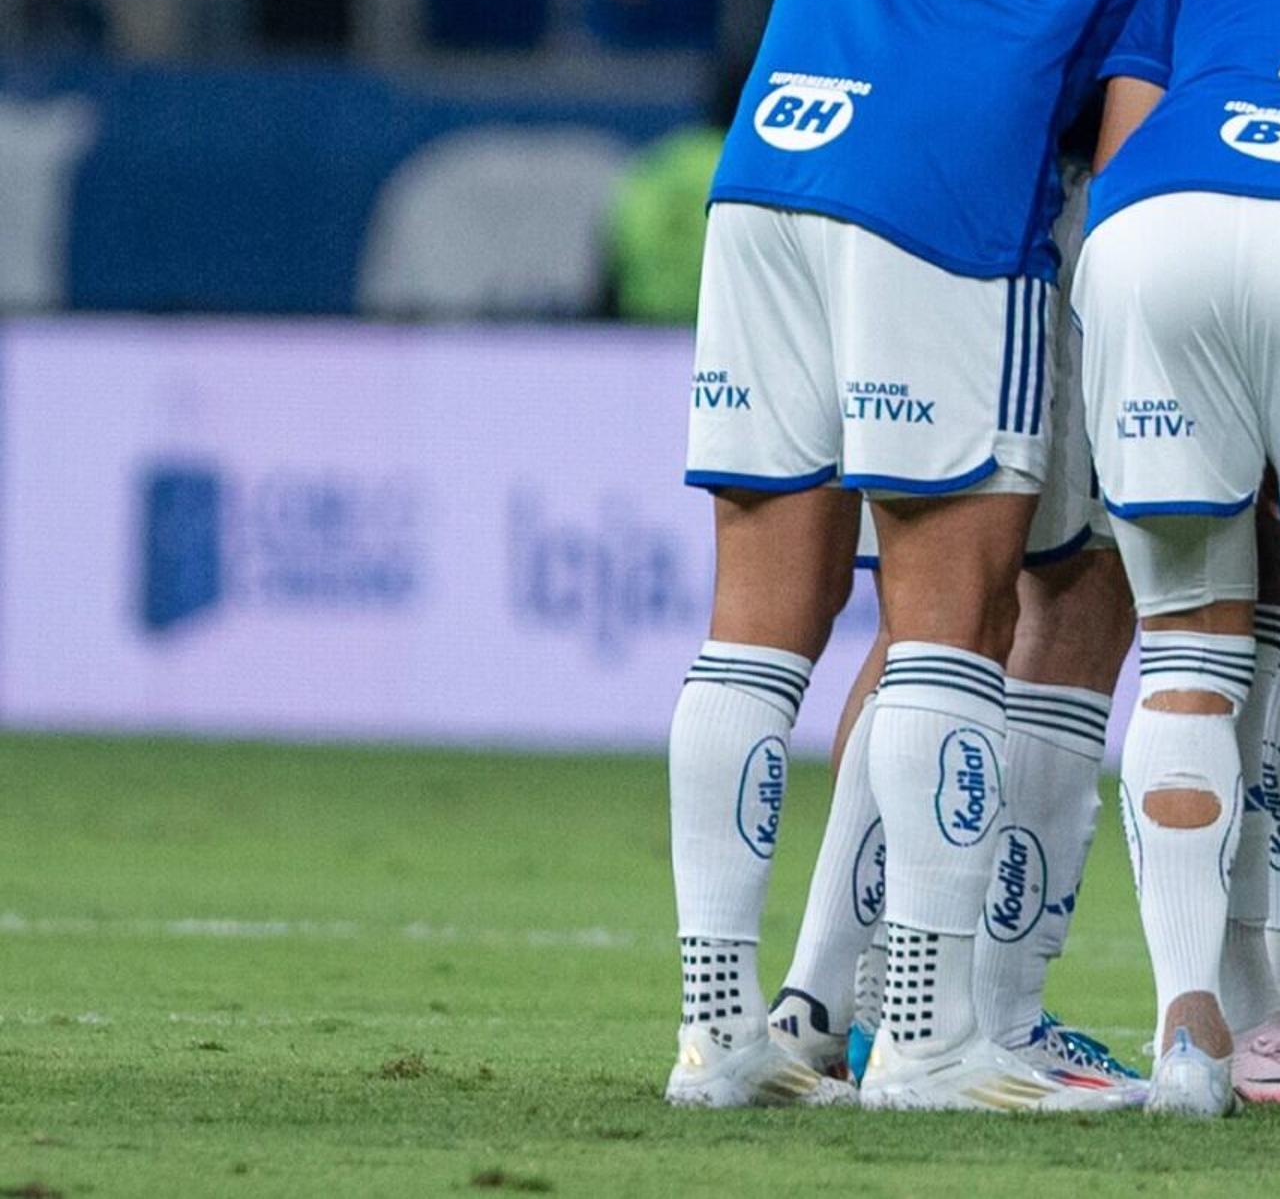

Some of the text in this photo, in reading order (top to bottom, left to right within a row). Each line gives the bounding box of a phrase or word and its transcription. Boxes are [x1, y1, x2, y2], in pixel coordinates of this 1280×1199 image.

[762, 95, 846, 135] BH
[755, 746, 783, 845] Kodilar
[952, 739, 987, 833] Kodilar
[991, 834, 1029, 932] Kodilar
